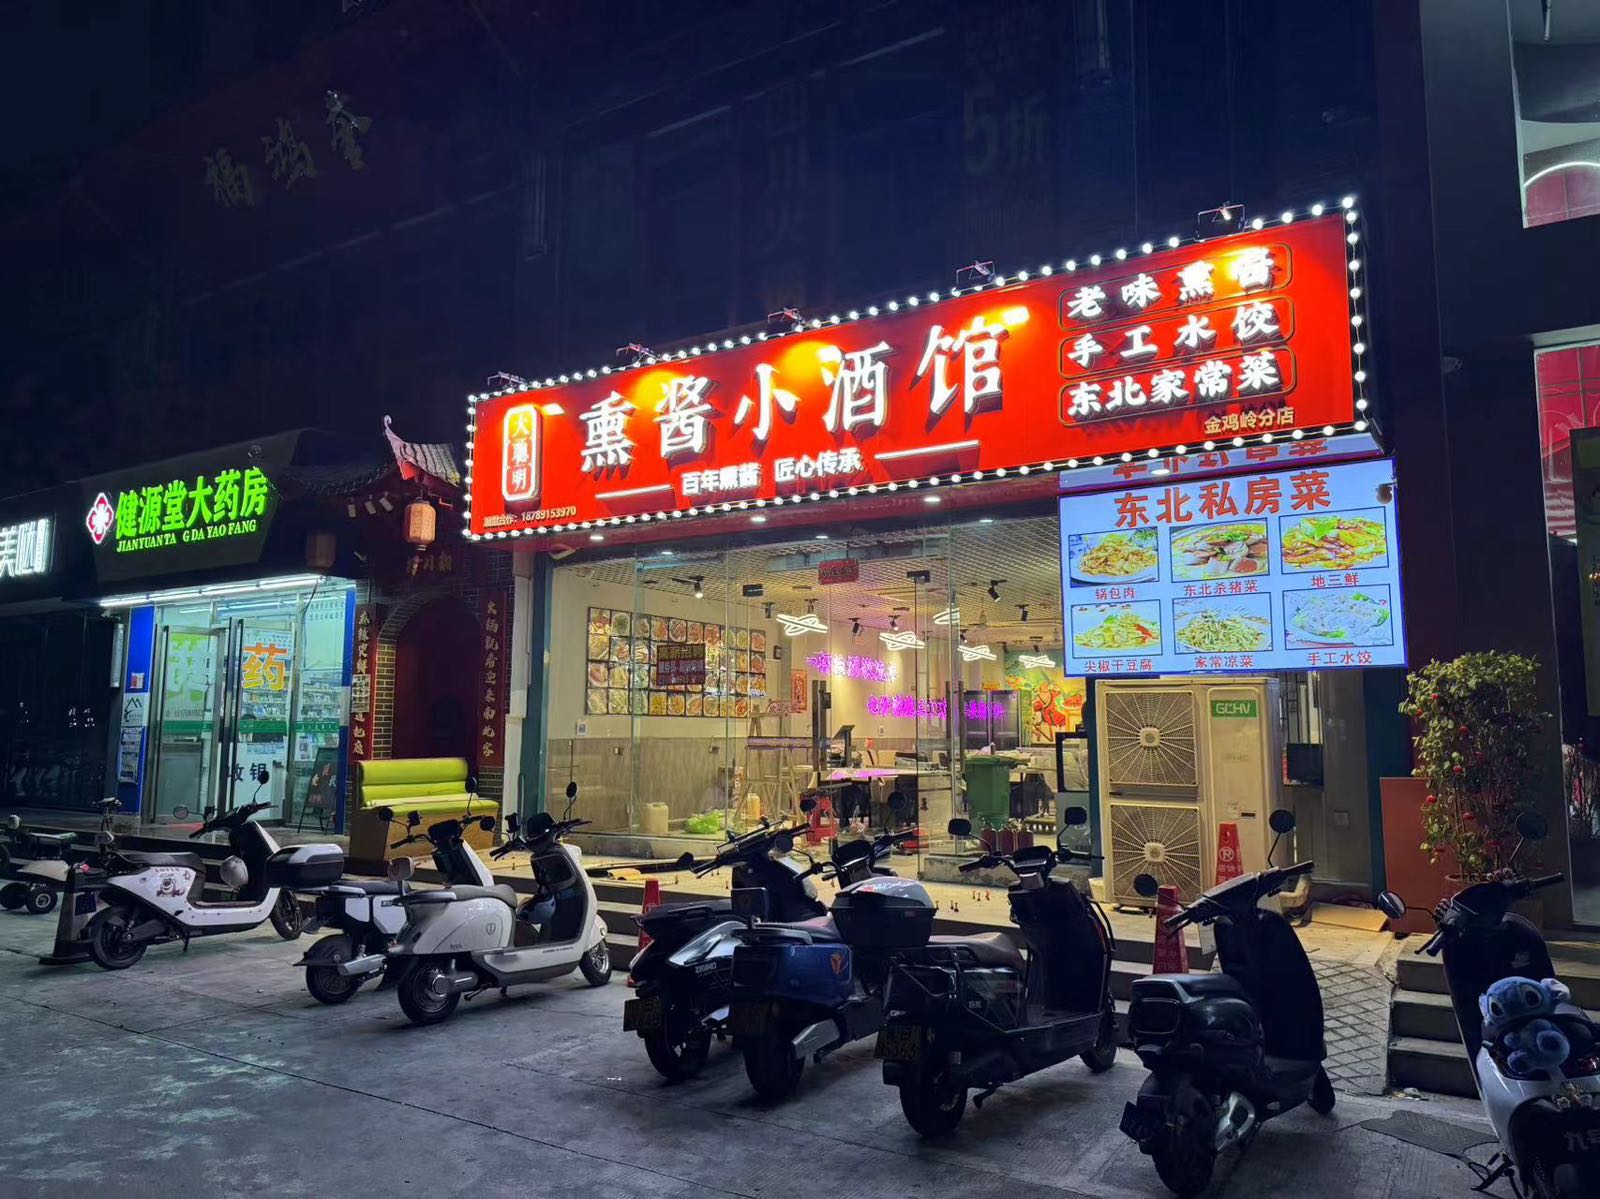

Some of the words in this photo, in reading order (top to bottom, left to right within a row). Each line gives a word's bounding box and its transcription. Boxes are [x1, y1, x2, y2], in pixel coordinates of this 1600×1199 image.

[1067, 246, 1276, 320] 老味熏酱
[1068, 302, 1280, 369] 手工水饺
[1068, 350, 1281, 417] 东北家常菜
[580, 324, 1004, 472] 熏酱小酒馆
[1204, 407, 1294, 435] 金鸡岭分店
[774, 446, 864, 483] 匠心传承
[115, 466, 268, 539] 健源堂大药房
[521, 505, 577, 522] 18789153970
[1114, 471, 1331, 529] 东北私房菜
[228, 519, 257, 536] FANG
[1096, 586, 1136, 600] 锅包肉
[1184, 579, 1258, 597] 东北杀猪菜
[1311, 572, 1360, 588] 地三鲜
[243, 642, 288, 692] 药
[1084, 657, 1153, 673] 尖椒干豆腐
[1194, 655, 1255, 668] 家常凉菜
[1307, 650, 1373, 666] 手工水饺
